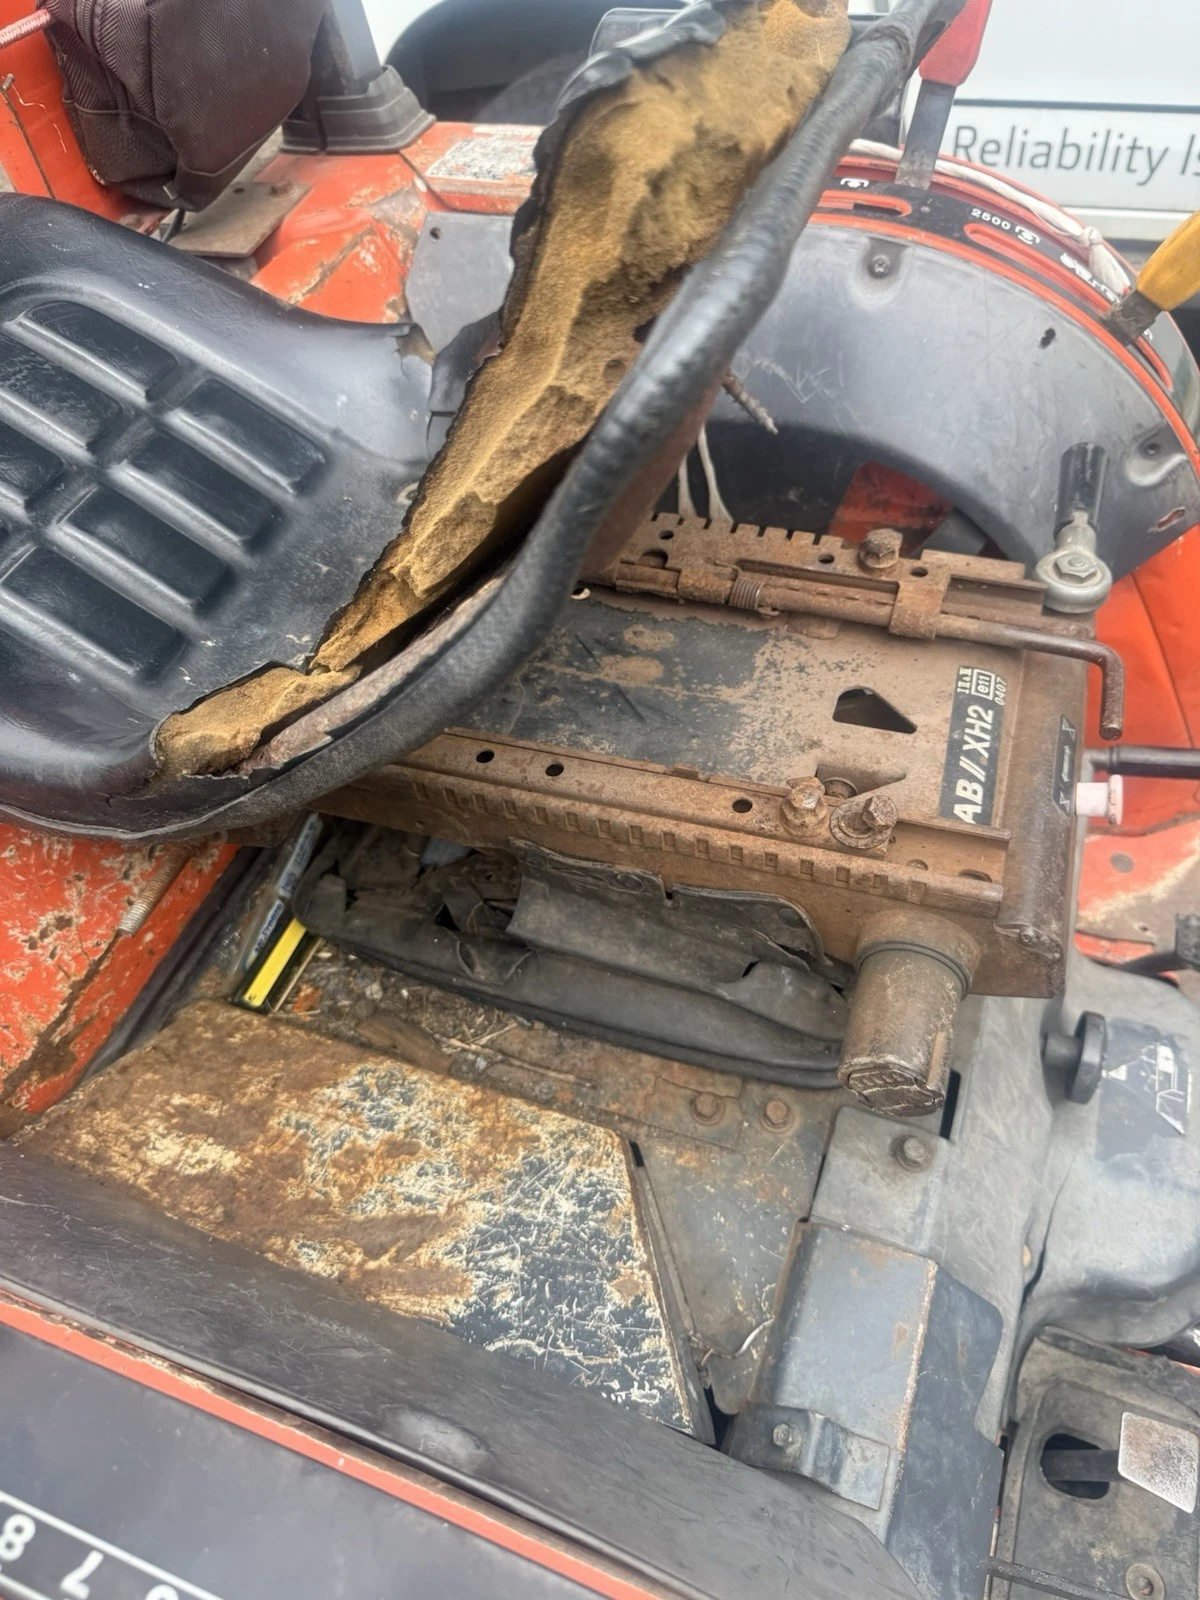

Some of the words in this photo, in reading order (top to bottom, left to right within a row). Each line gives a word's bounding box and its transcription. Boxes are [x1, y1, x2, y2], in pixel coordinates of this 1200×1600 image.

[953, 125, 1169, 187] Reliability
[971, 208, 1011, 230] 2500
[976, 673, 990, 694] e11
[994, 677, 1007, 706] 0407
[0, 1513, 36, 1562] 8
